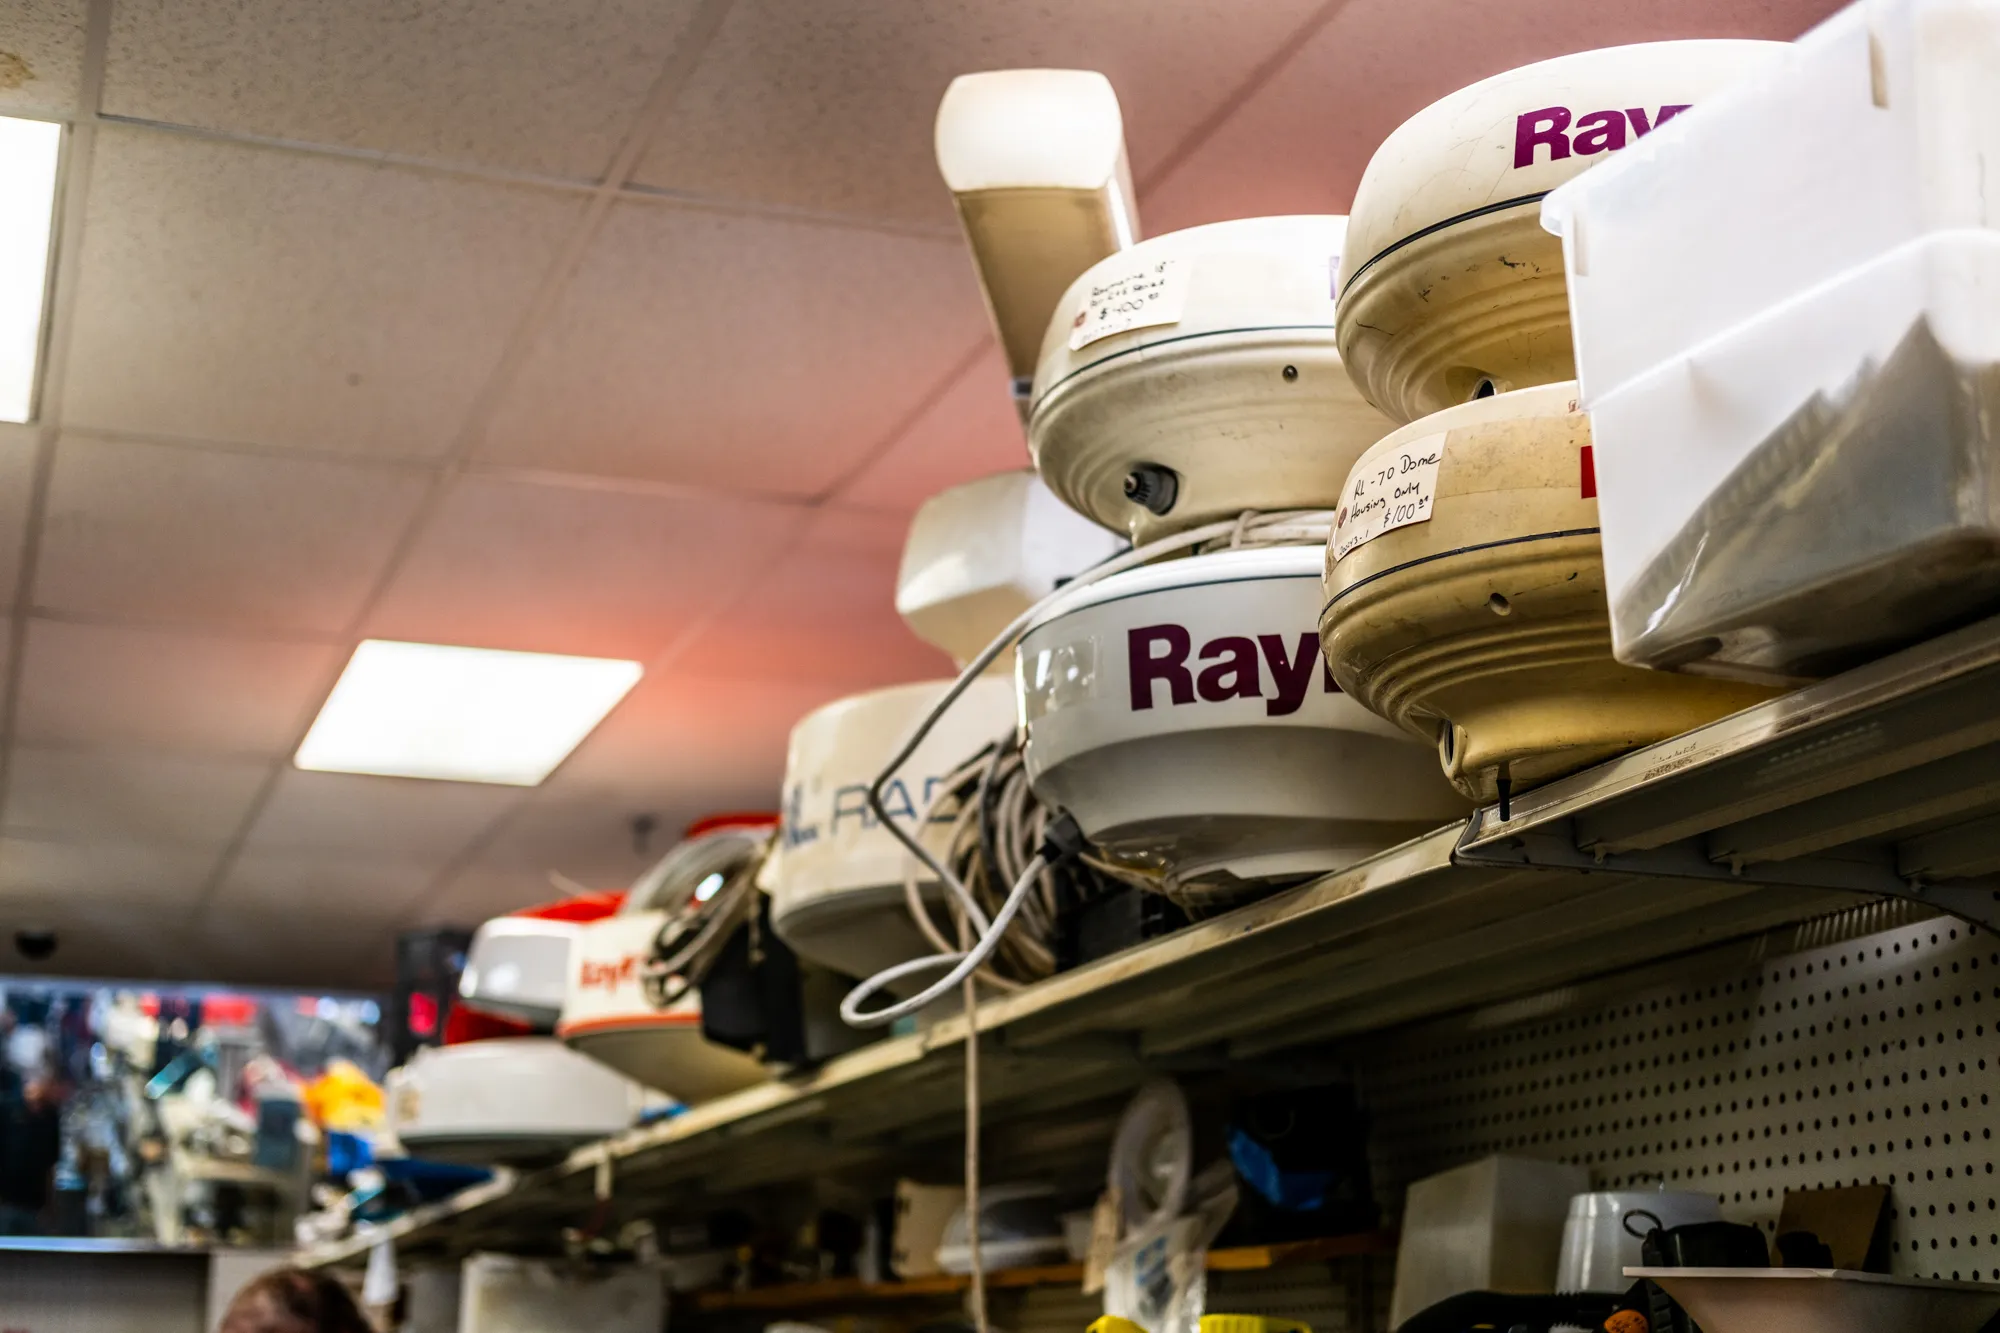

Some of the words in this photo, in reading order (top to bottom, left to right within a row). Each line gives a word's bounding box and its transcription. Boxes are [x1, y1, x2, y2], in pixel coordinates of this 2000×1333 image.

[1400, 453, 1441, 474] Dome
[1350, 497, 1386, 523] Housing
[1394, 482, 1420, 499] Only
[1128, 624, 1345, 716] Ray
